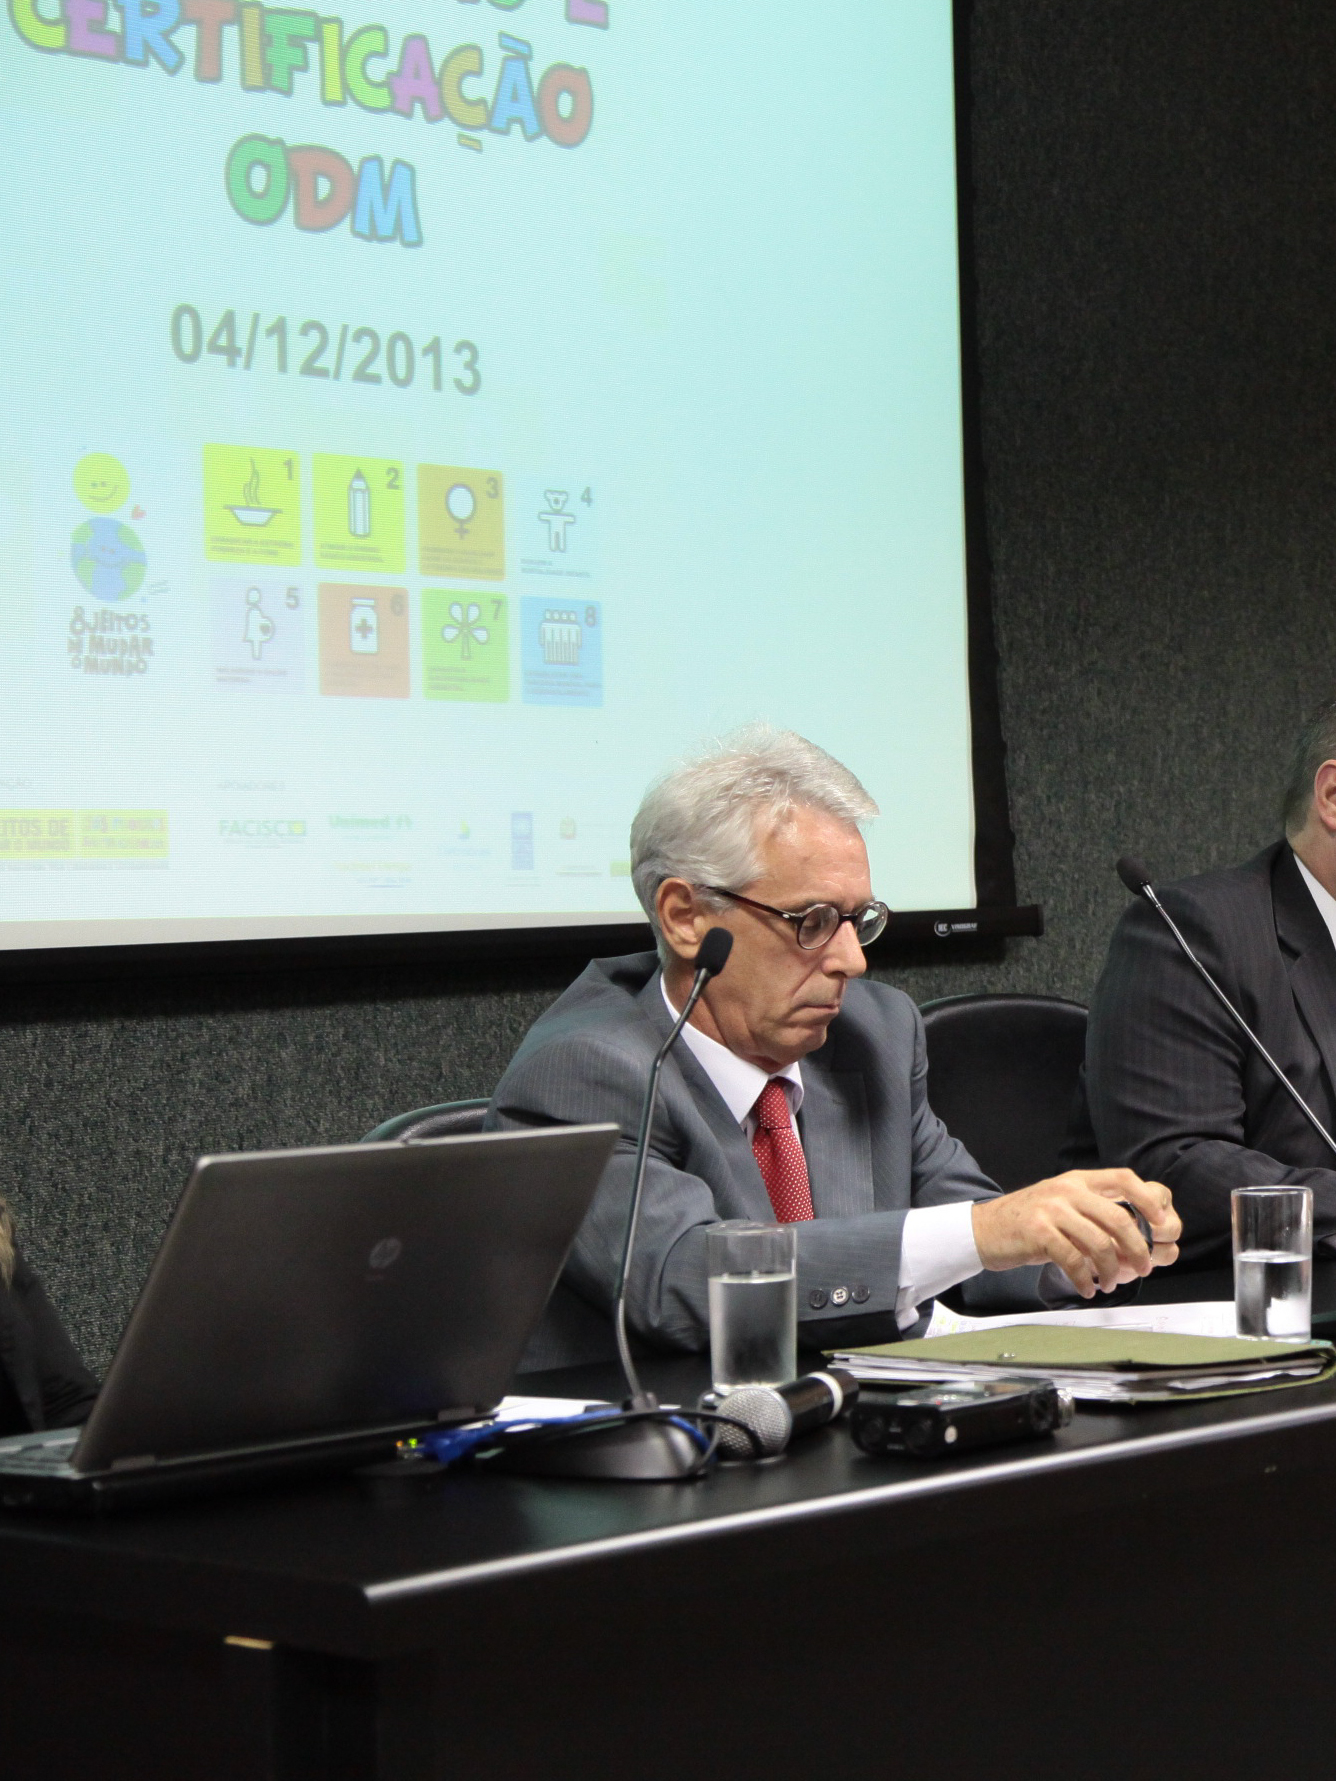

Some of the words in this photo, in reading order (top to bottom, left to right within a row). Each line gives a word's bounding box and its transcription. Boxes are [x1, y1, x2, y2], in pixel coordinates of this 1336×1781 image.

[6, 0, 594, 151] CERTIFICAÇÃO
[225, 133, 423, 248] ODM
[170, 303, 482, 396] 04/12/2013
[283, 458, 294, 481] 1
[386, 467, 400, 490] 2
[486, 477, 499, 499] 3
[580, 486, 593, 507] 4
[285, 586, 300, 610] 5
[491, 598, 503, 621] 7
[585, 605, 597, 628] 8
